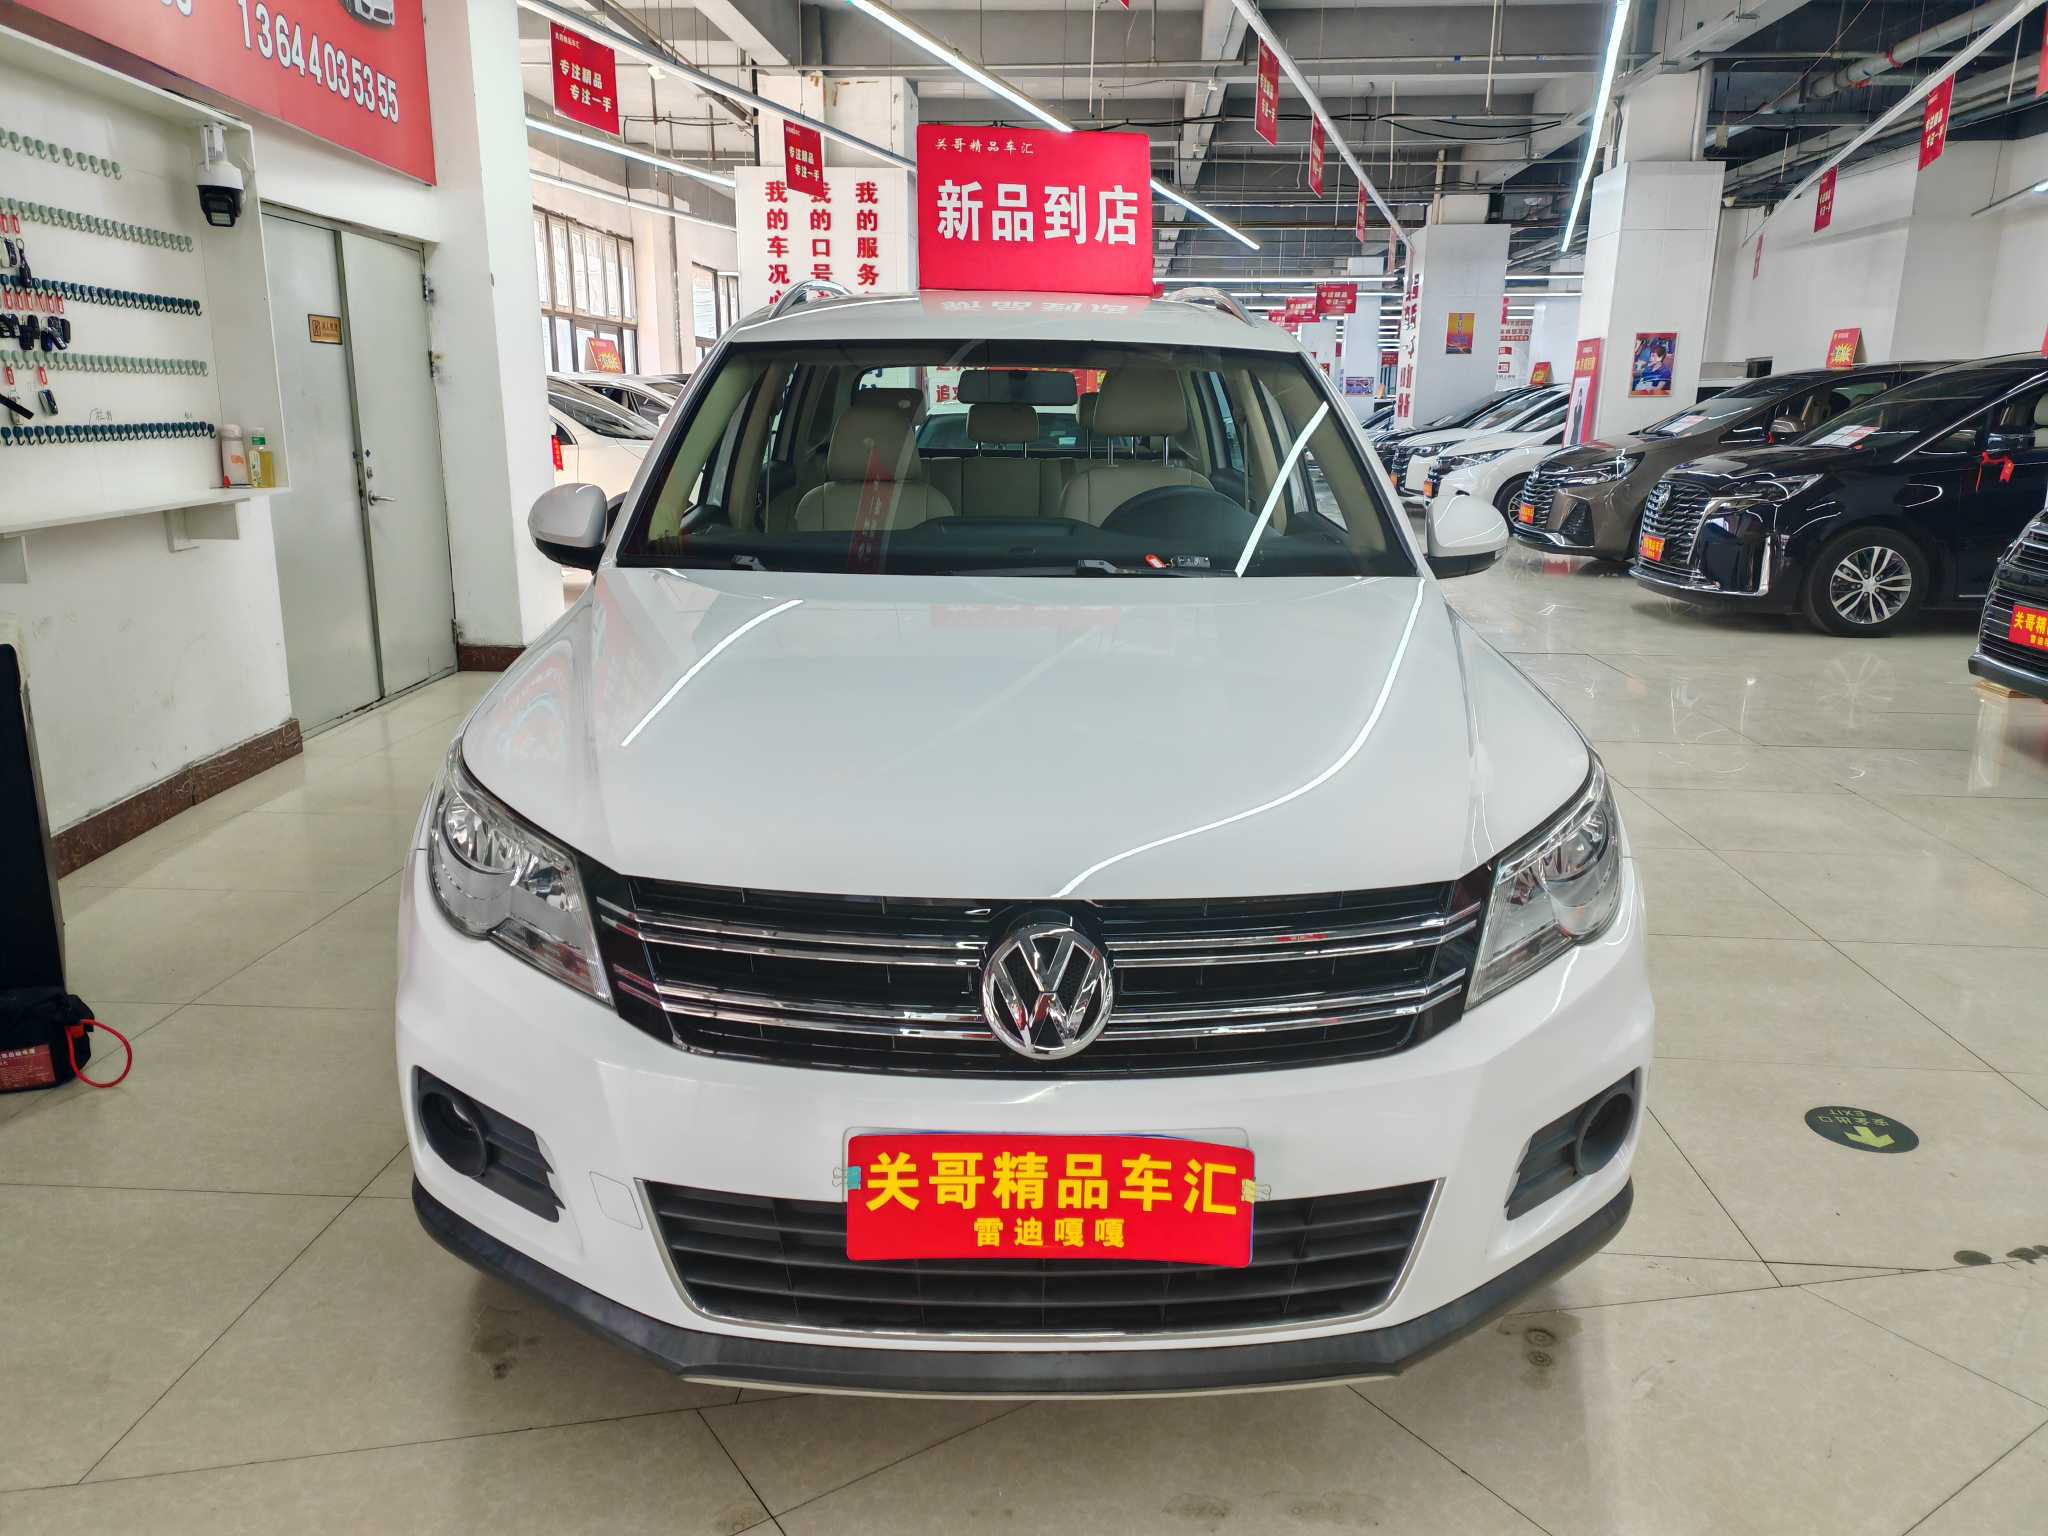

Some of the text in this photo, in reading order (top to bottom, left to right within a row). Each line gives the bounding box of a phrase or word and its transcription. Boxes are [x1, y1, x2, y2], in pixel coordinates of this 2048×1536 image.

[237, 0, 399, 123] 13644035355
[559, 59, 603, 90] 专注精品
[569, 84, 613, 113] 专注一手
[935, 137, 1035, 160] 关哥精品车汇
[936, 179, 1139, 245] 新品到店
[866, 1152, 1238, 1216] 关哥精品车汇
[973, 1217, 1126, 1249] 雷迪嘎嘎
